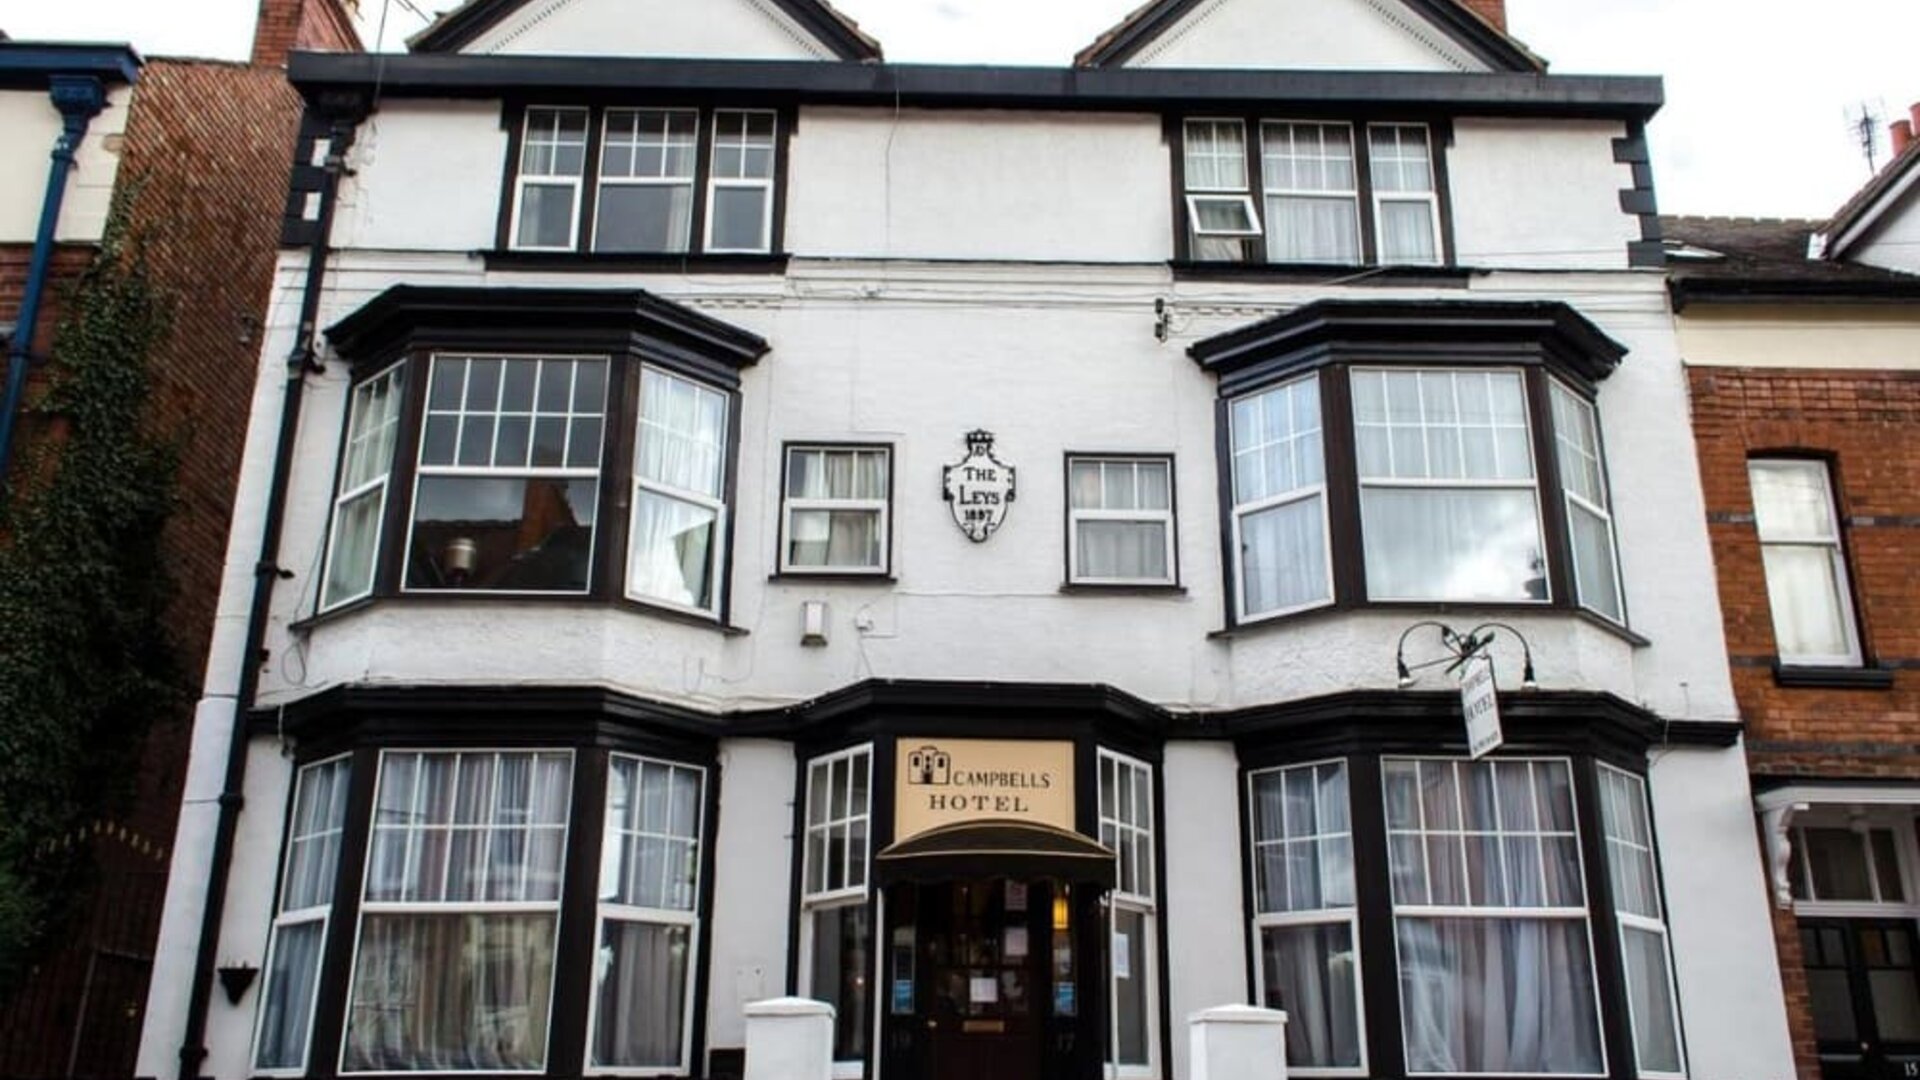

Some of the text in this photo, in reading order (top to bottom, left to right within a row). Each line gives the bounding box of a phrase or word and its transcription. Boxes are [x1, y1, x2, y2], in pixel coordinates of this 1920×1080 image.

[962, 466, 997, 482] THE
[959, 484, 1000, 505] LEYS
[953, 770, 1051, 789] CAMPBELLS
[928, 794, 1029, 813] HOTEL
[1904, 1061, 1919, 1077] 15
